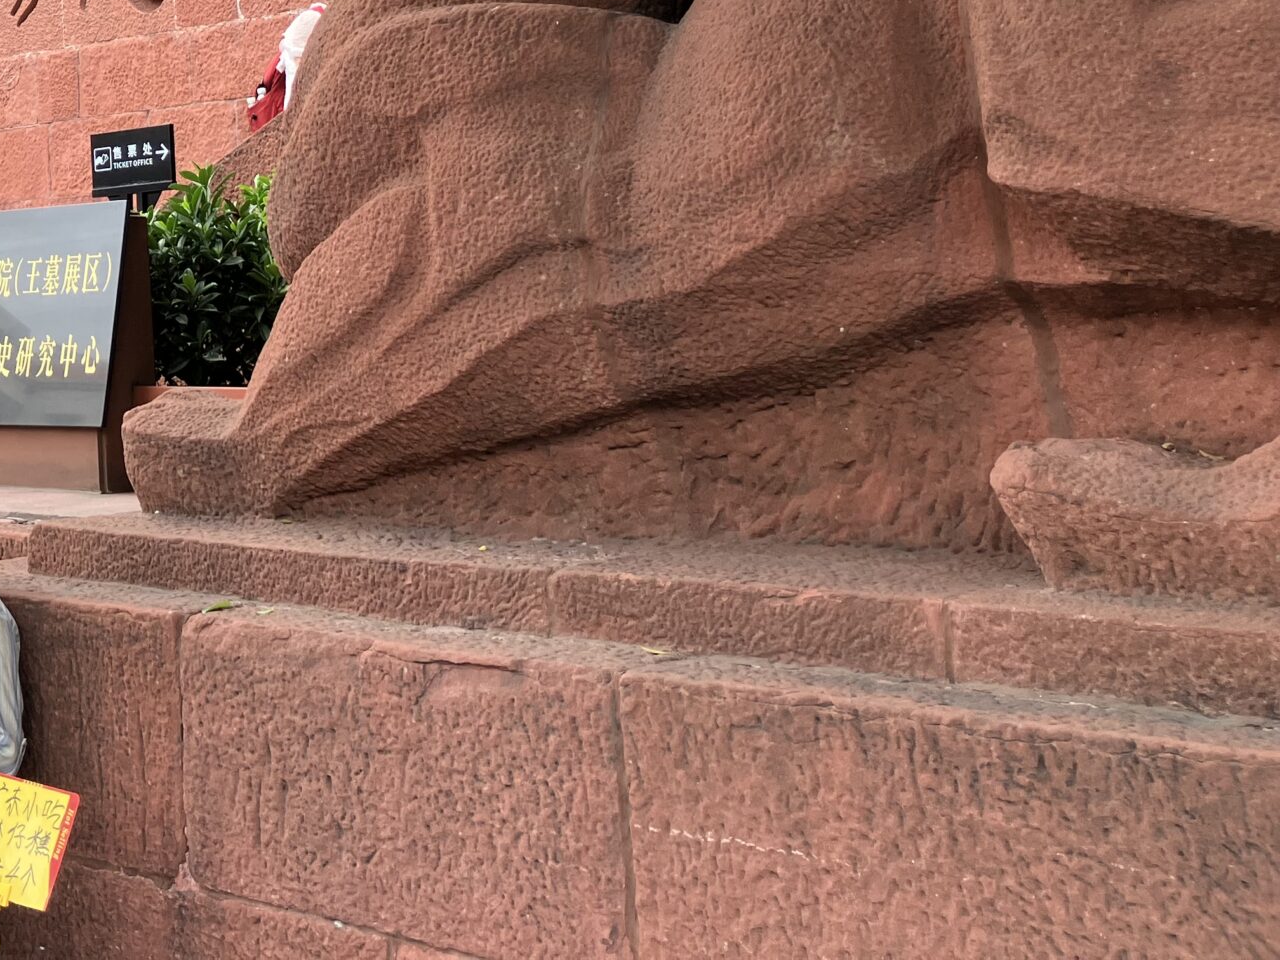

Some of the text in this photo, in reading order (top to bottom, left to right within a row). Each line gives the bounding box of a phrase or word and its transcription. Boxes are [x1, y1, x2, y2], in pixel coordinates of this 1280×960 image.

[112, 141, 153, 160] 售票处
[113, 157, 153, 169] TICKET OFFICE
